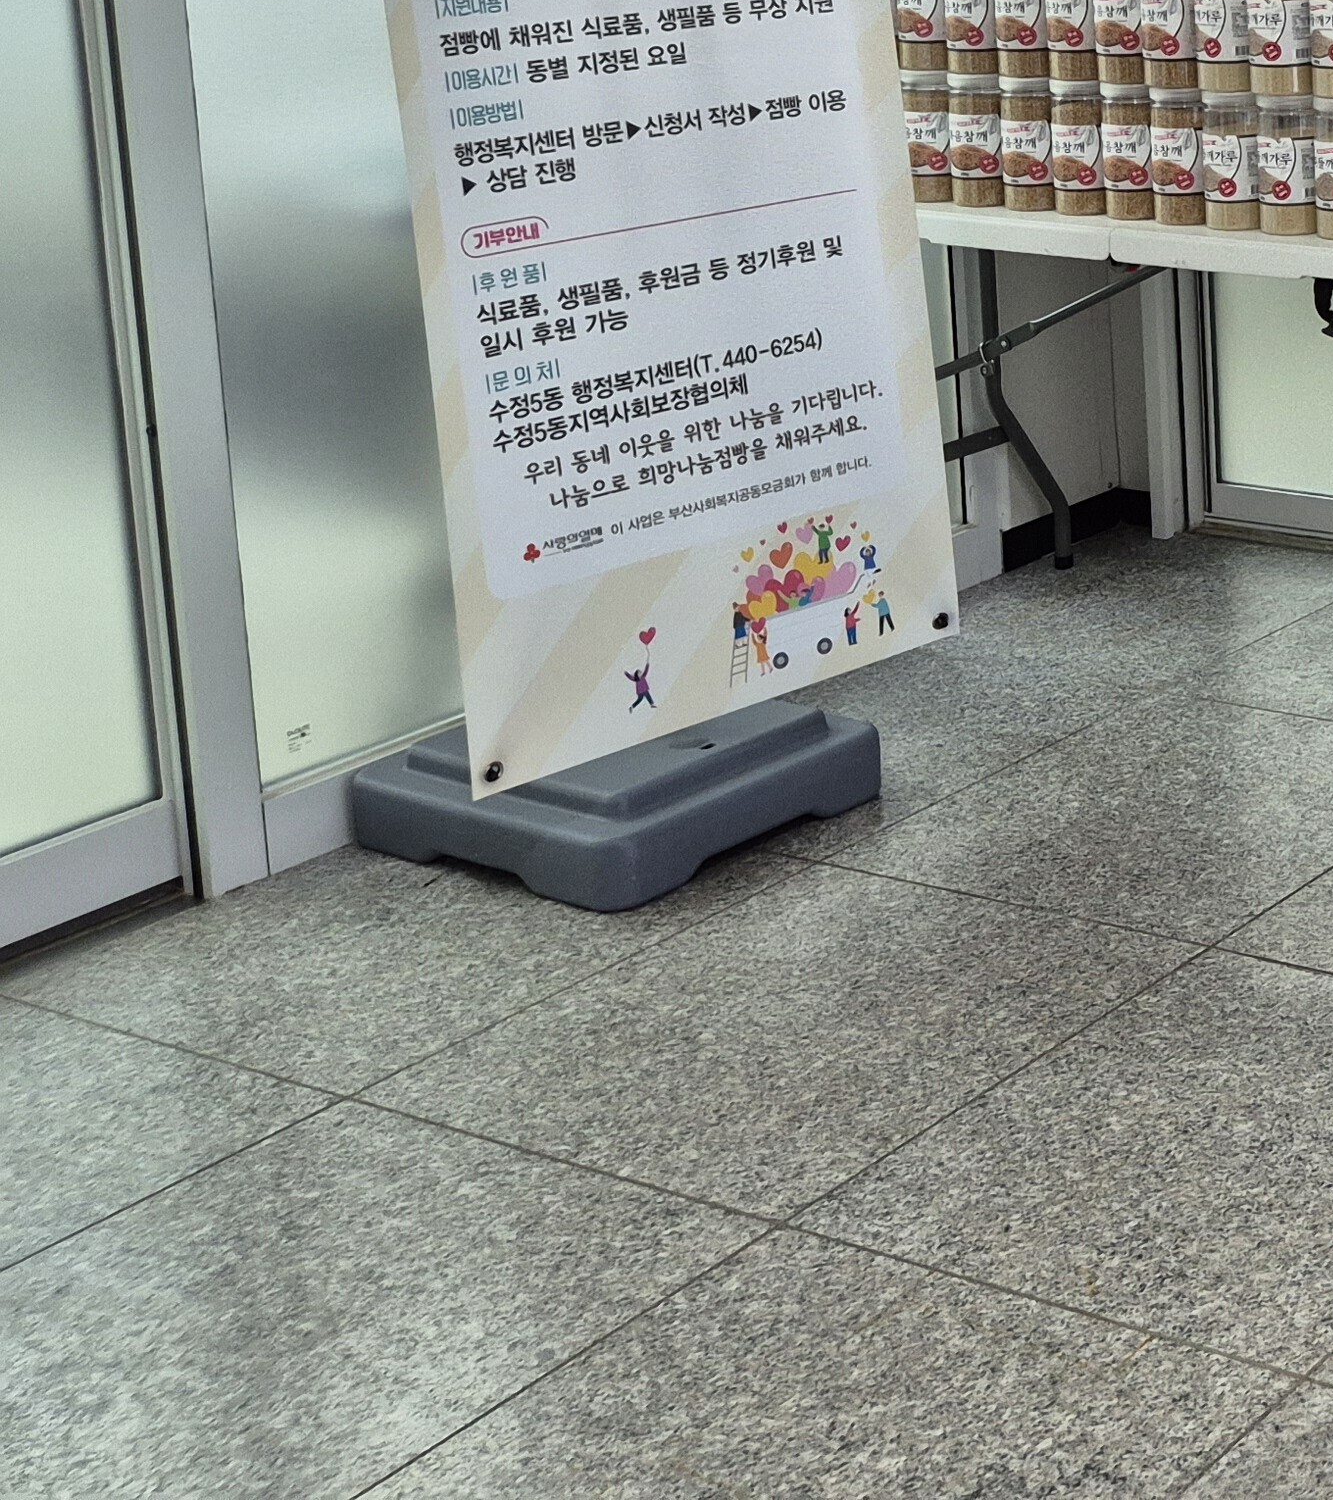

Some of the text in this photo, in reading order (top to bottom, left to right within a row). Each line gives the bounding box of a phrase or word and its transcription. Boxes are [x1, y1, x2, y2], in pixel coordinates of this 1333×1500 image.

[439, 26, 501, 58] 점빵에
[509, 18, 574, 48] 채워진
[581, 12, 649, 40] 식료품,
[657, 4, 716, 33] 생필품
[722, 1, 742, 25] 등
[526, 55, 569, 84] 동별
[577, 46, 640, 76] 지정된
[647, 41, 687, 67] 요일
[454, 89, 846, 168] 행정복지센터 방문 신청서 작성 점빵 이용
[486, 157, 576, 194] 상담 진행
[472, 223, 541, 250] 기부안내
[477, 234, 843, 326] 식료품, 생필품, 후원금 등 정기후원 및
[480, 308, 629, 359] 일시 후원 가능
[489, 386, 564, 425] 수정5동
[493, 372, 748, 454] 수정5동지역사회보장협의체
[524, 379, 883, 486] 우리 동네 이웃을 위한 나눔을 기다립니다.
[549, 415, 867, 509] 나눔으로 희망나눔점빵을 채워주세요.
[611, 520, 623, 535] 이
[628, 510, 665, 531] 사업은
[668, 471, 806, 521] 부산사회복지공동모금회가
[810, 464, 832, 483] 함께
[836, 455, 871, 476] 합니다.
